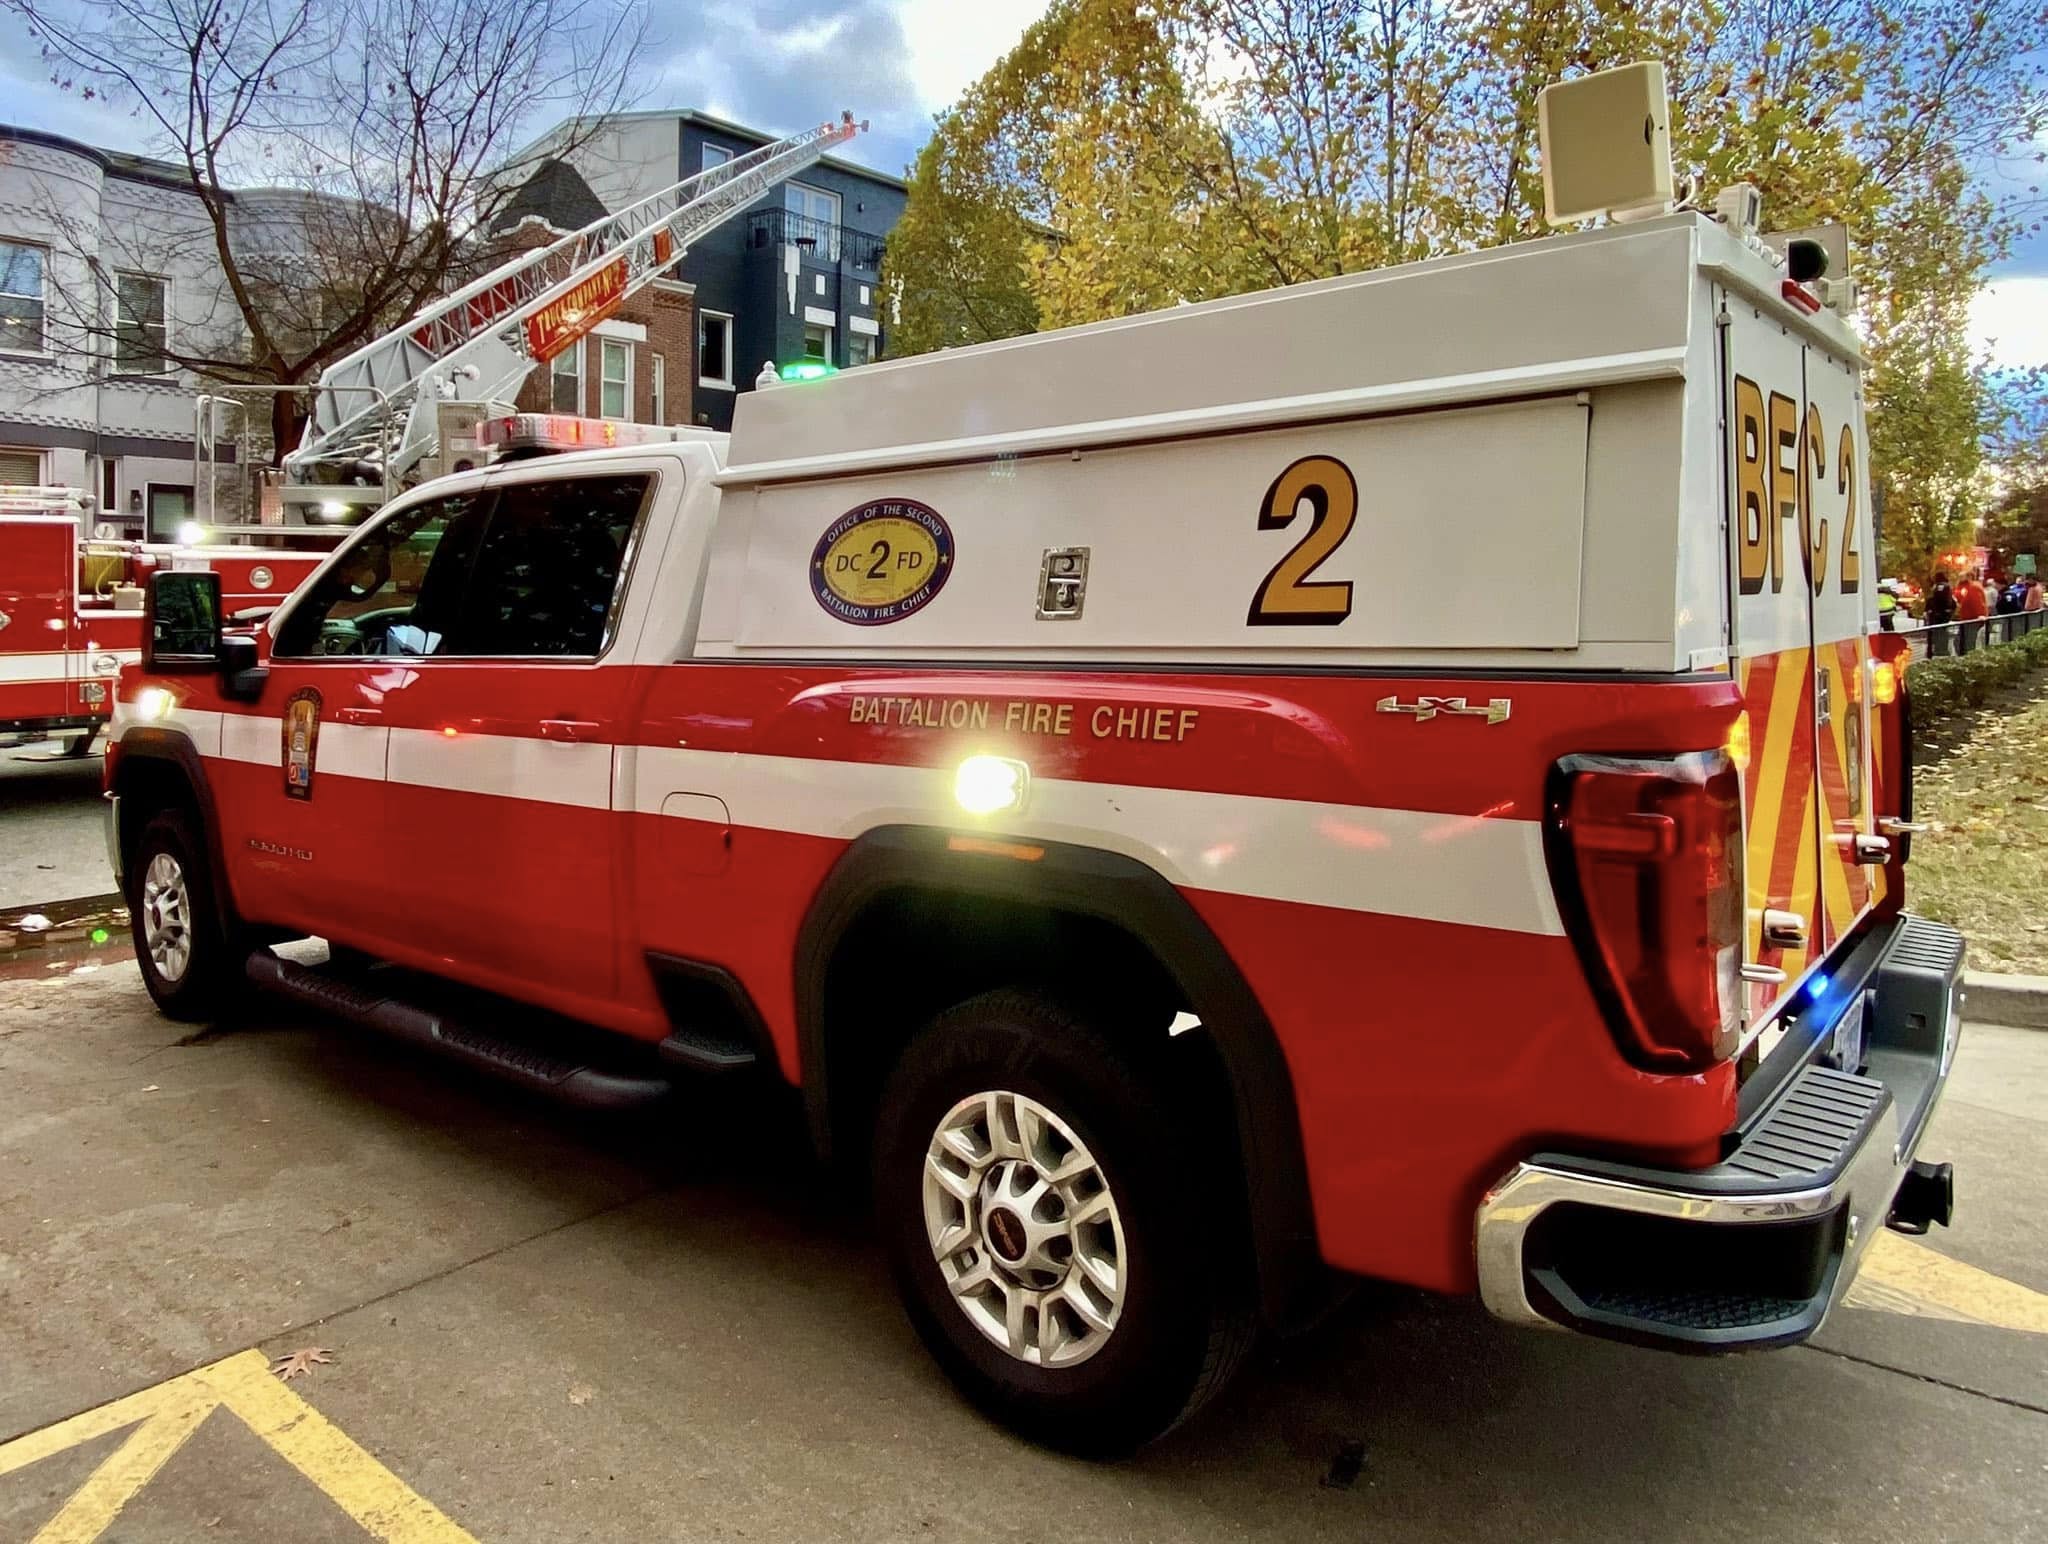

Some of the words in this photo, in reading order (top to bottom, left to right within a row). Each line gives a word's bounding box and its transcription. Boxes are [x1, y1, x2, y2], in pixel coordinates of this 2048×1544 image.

[1734, 373, 1827, 597] BFC
[1838, 423, 1859, 594] 2
[827, 515, 859, 543] OFFICE
[864, 507, 879, 519] OF
[883, 505, 901, 515] THE
[905, 506, 943, 537] SECOND
[1246, 454, 1358, 626] 2
[836, 553, 862, 572] DC
[866, 540, 890, 579] 2
[897, 552, 922, 569] FD
[820, 588, 869, 618] BATTALION
[873, 606, 896, 618] FIRE
[901, 585, 932, 611] CHIEF
[849, 696, 990, 729] BATTALION
[1004, 702, 1074, 735] FIRE
[1091, 705, 1200, 741] CHIEF
